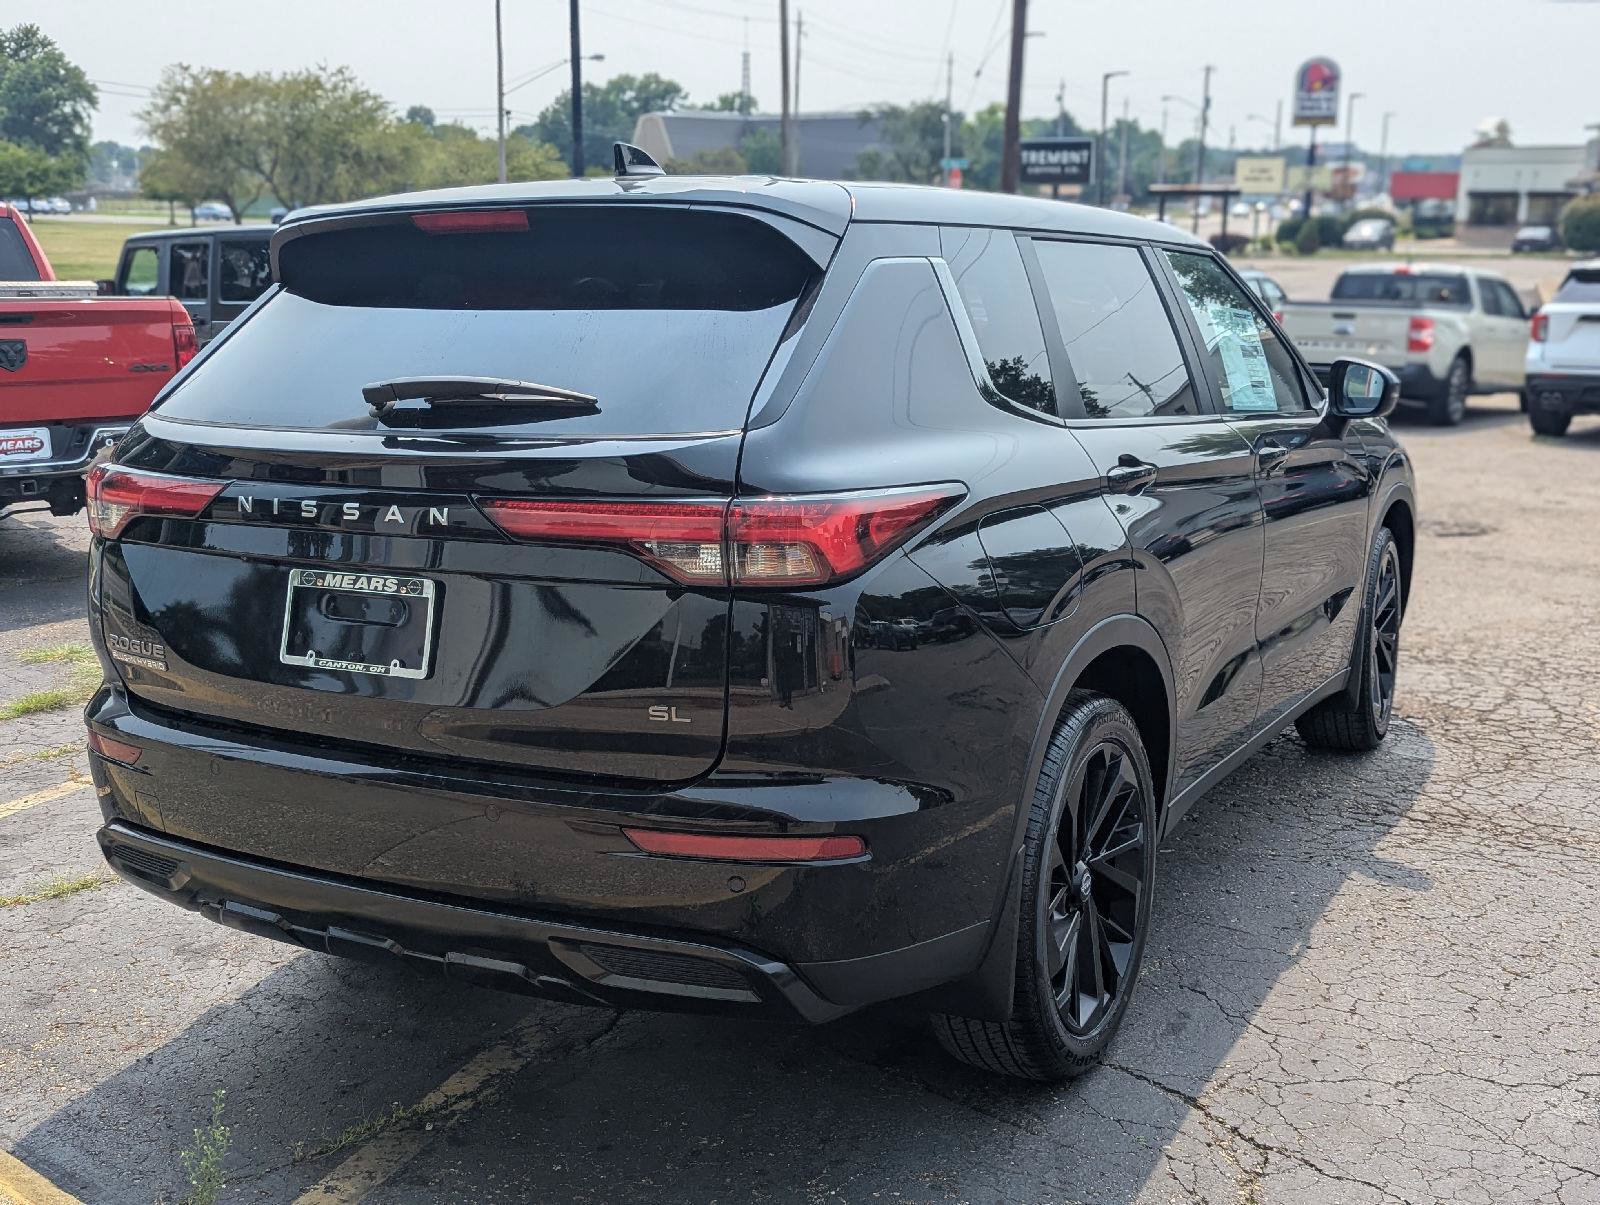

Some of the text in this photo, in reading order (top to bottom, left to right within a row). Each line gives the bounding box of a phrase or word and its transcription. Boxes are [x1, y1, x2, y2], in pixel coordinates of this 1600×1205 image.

[1020, 149, 1089, 165] TREMONT
[237, 495, 449, 526] NISSAN
[323, 573, 399, 593] MEARS
[108, 633, 165, 658] ROGUE
[648, 704, 692, 723] SL
